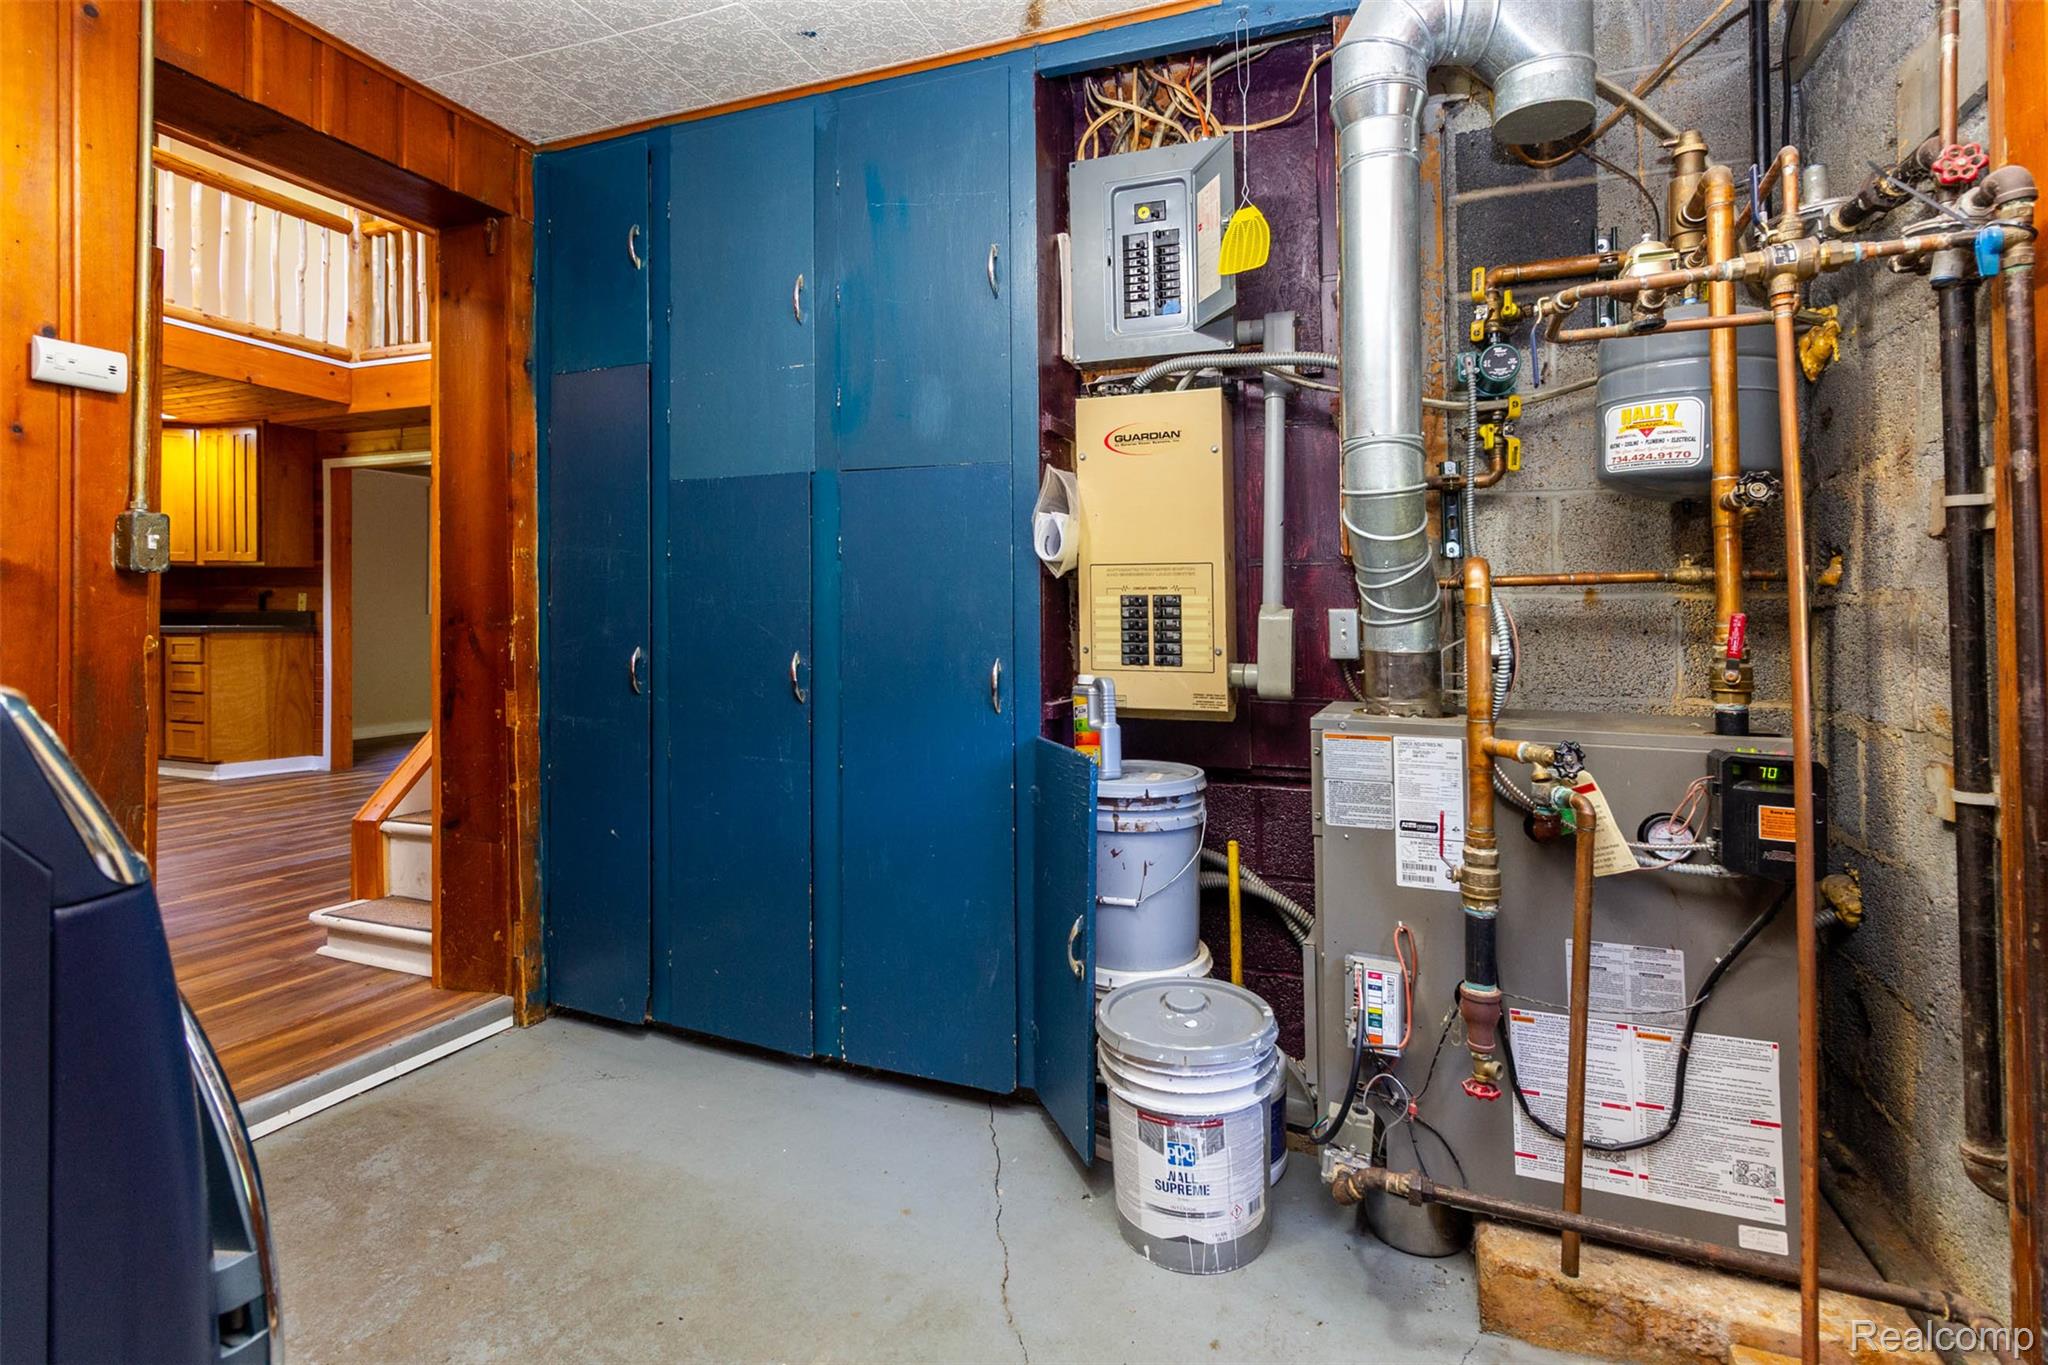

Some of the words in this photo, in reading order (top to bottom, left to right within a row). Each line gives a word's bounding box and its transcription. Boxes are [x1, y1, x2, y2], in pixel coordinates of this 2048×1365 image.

[1621, 402, 1679, 424] HALEY
[1114, 430, 1181, 443] GUARDIAN
[1611, 450, 1691, 464] 734.424.9170
[1759, 766, 1778, 779] 70
[1154, 1178, 1211, 1196] SUPREME
